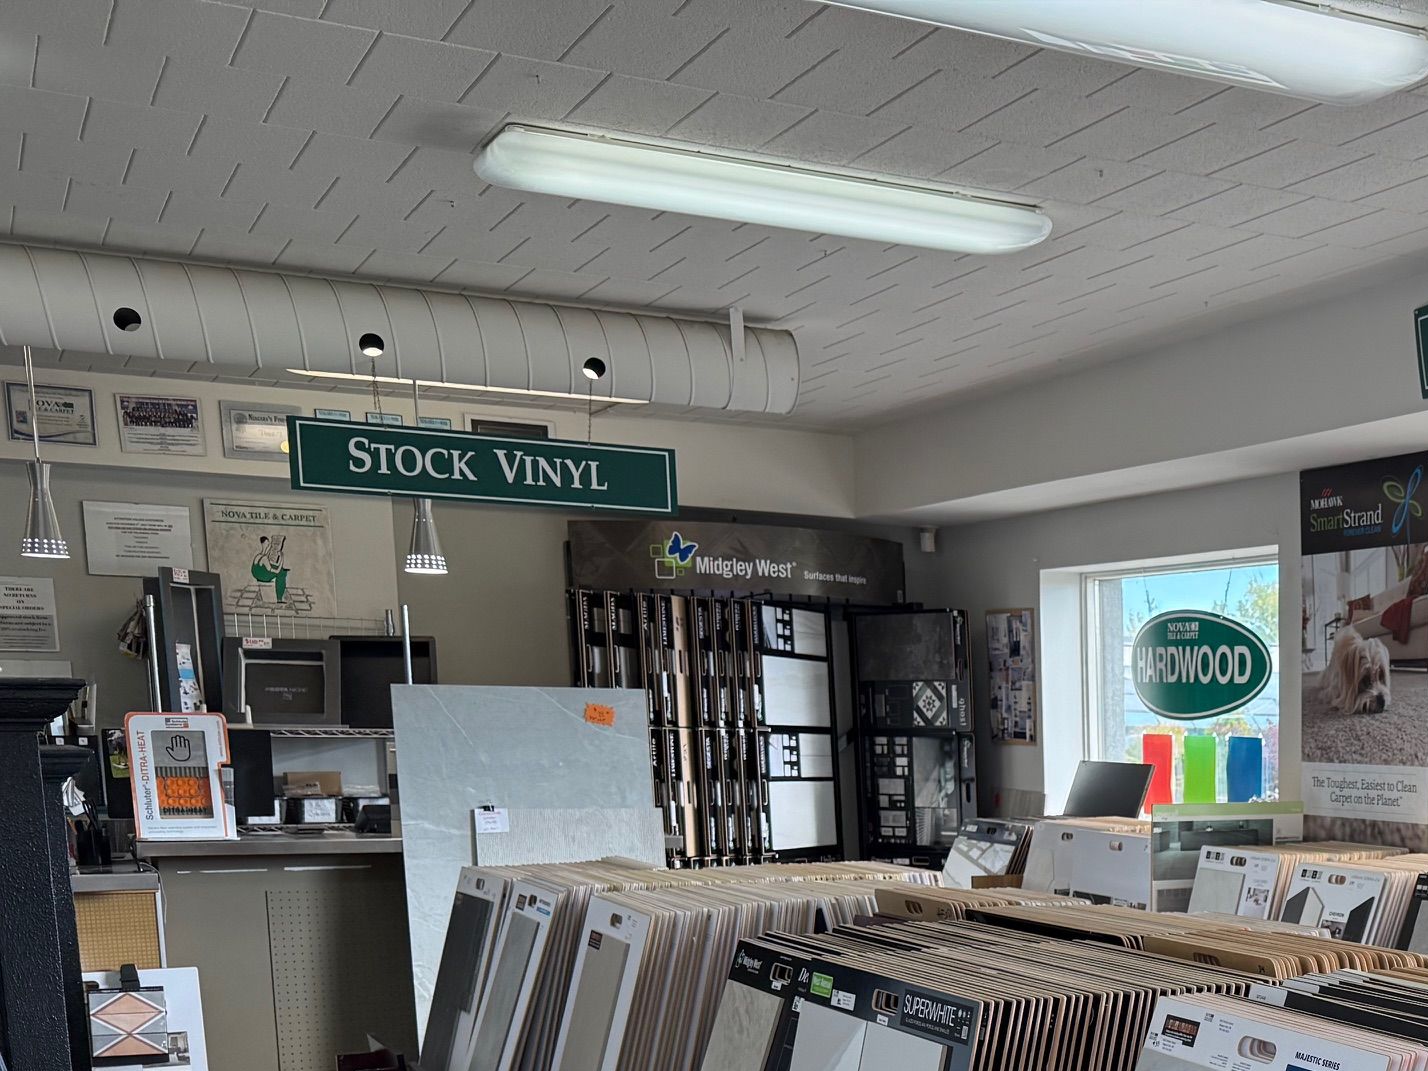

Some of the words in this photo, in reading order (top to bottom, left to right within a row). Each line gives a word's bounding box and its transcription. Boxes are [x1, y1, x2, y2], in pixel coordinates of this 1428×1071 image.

[348, 437, 478, 482] STOCK
[493, 448, 608, 491] VINYL
[221, 509, 247, 520] NOVA
[248, 511, 270, 521] TILE
[271, 512, 279, 521] &
[280, 513, 318, 523] CARPET
[1310, 503, 1383, 532] SmartStrand
[696, 556, 754, 579] Midgley
[804, 570, 834, 582] Surfaces
[835, 573, 848, 583] that
[1167, 622, 1191, 632] NOVA
[1167, 632, 1176, 640] TILE
[1181, 631, 1199, 639] CARPET
[1137, 645, 1252, 684] HARDWOOD
[1312, 776, 1325, 788] The
[1327, 777, 1360, 792] Toughest,
[1361, 779, 1386, 792] Easiest
[1387, 782, 1395, 792] to
[1395, 780, 1417, 793] Clean
[1330, 791, 1353, 807] Carpet
[1354, 795, 1363, 804] on
[1364, 793, 1376, 805] the
[904, 994, 957, 1026] SUPERWHITE
[1295, 1051, 1322, 1066] MAJESTIC
[1322, 1059, 1341, 1071] SERIES
